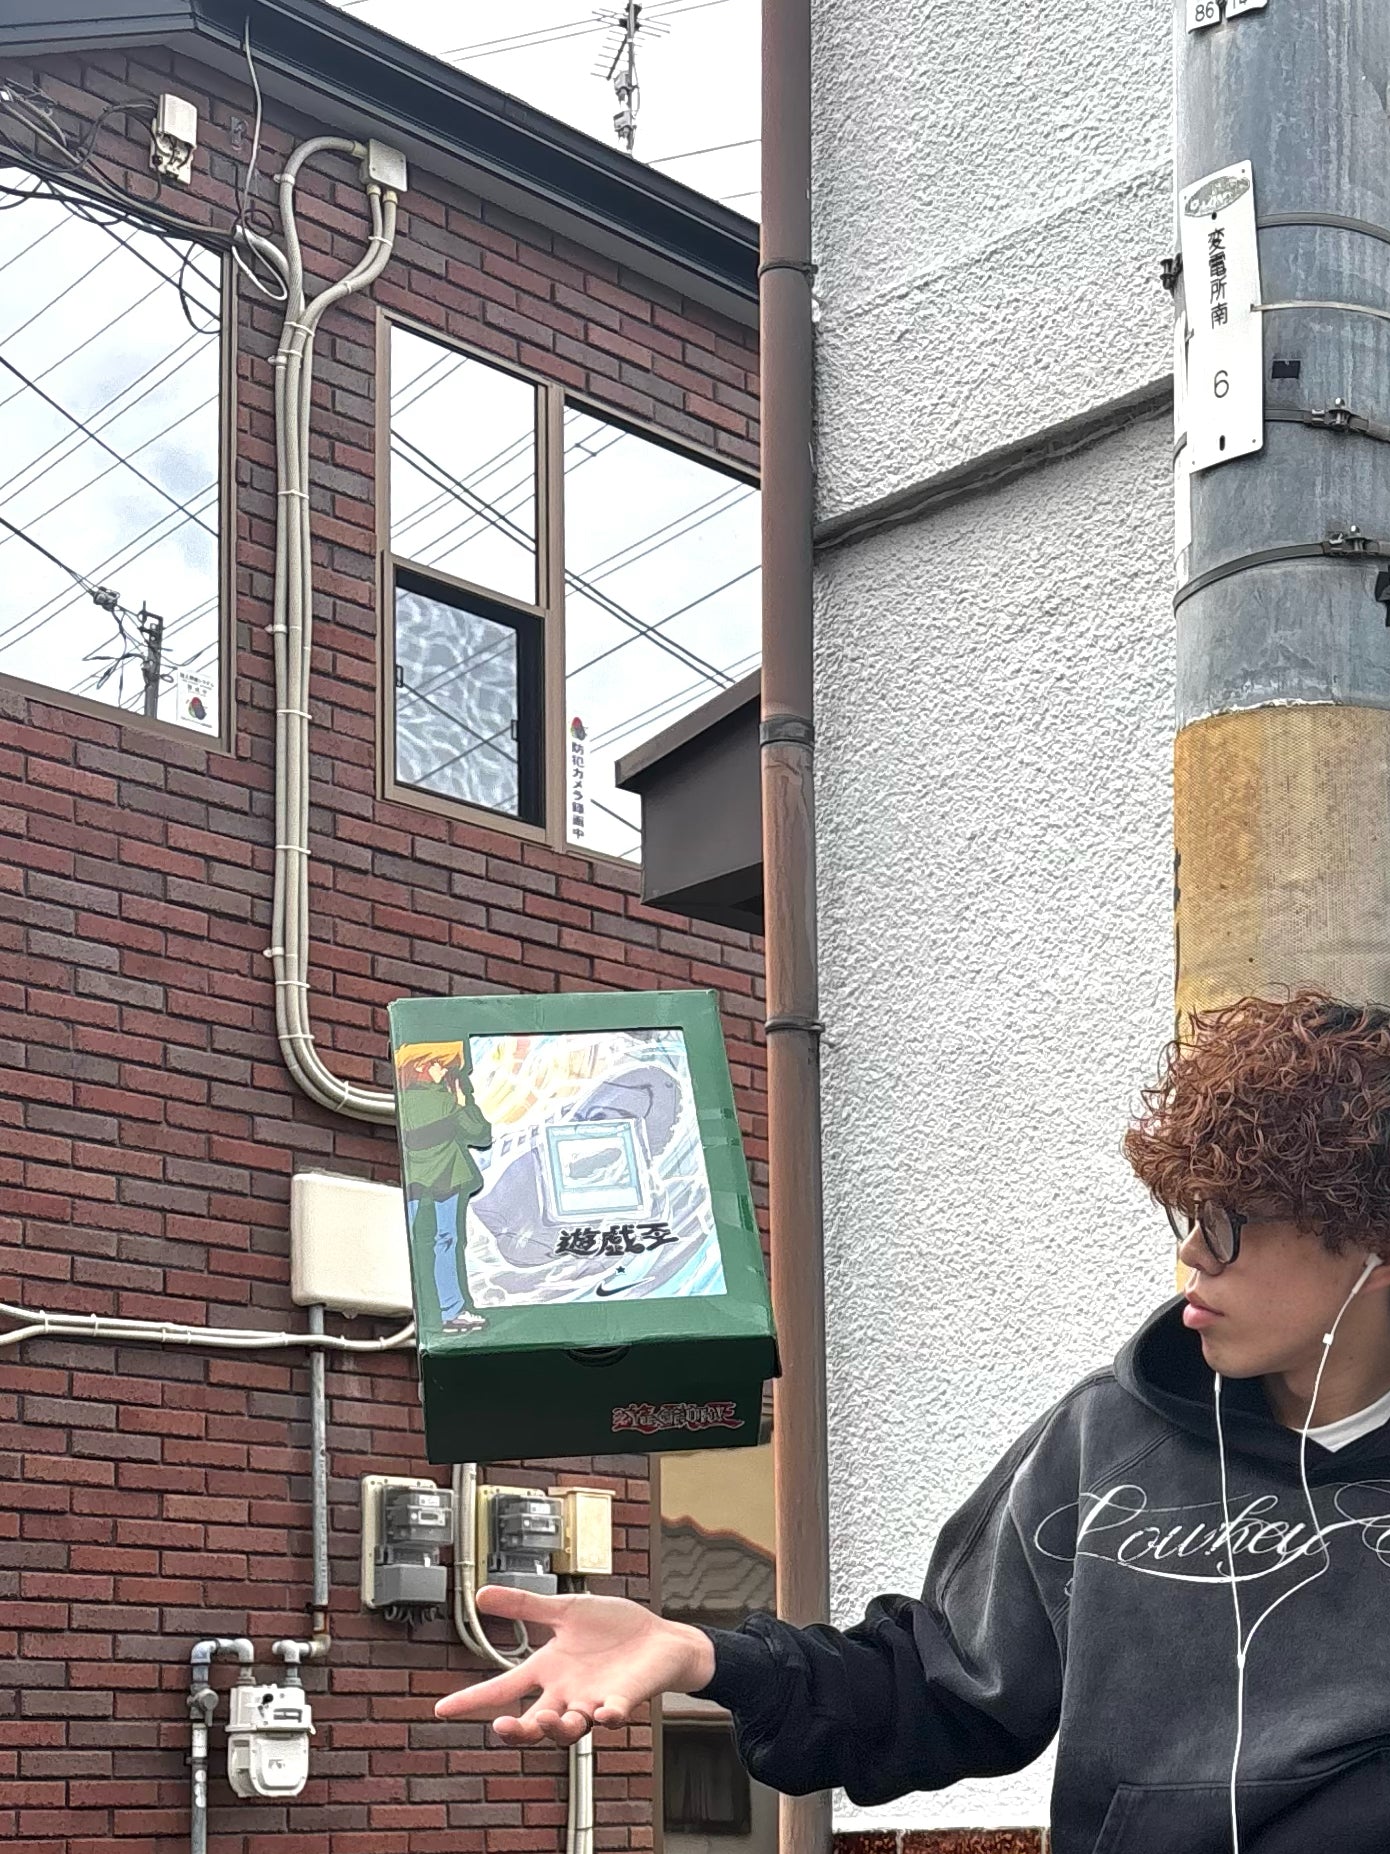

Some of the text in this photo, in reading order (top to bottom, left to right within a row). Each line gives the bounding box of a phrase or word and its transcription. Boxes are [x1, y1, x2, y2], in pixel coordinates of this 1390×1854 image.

[1195, 1, 1215, 22] 86
[1207, 227, 1230, 399] 変電所南 6
[555, 1222, 680, 1257] 遊戯王
